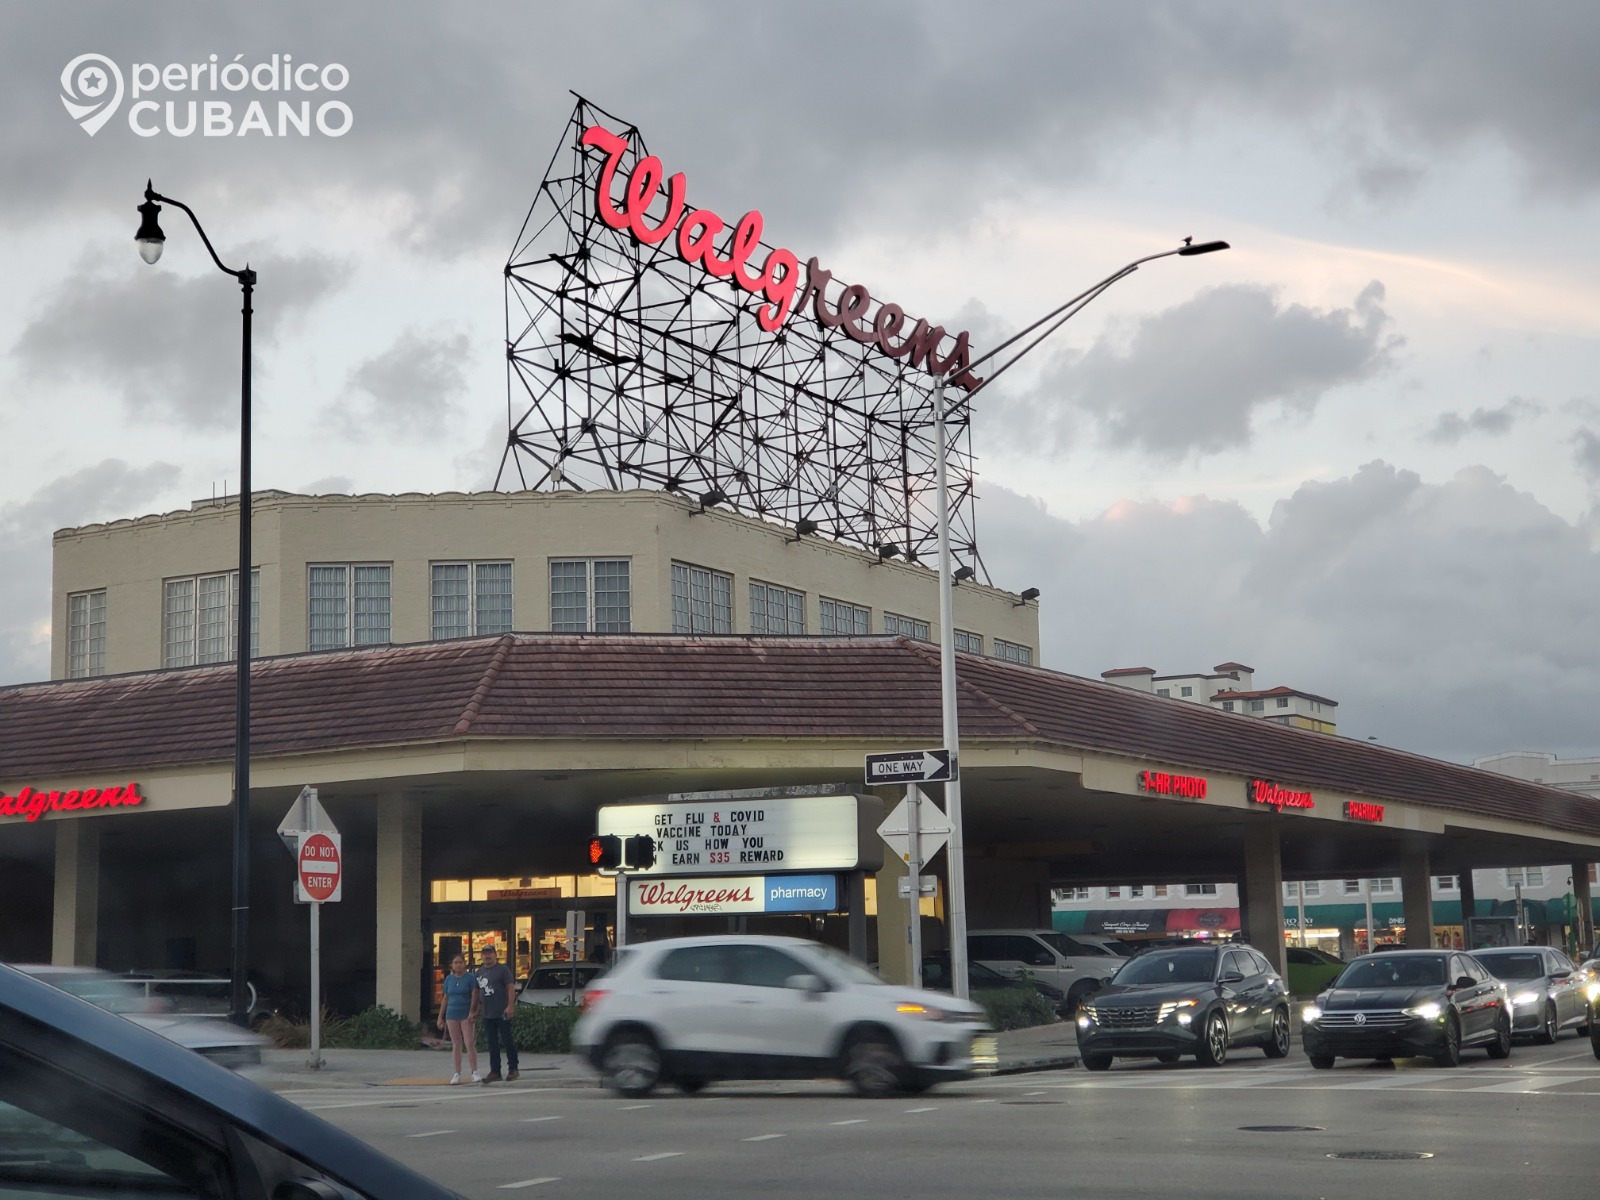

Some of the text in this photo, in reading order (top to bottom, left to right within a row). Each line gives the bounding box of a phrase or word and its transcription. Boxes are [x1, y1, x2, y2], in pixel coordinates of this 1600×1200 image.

[579, 125, 983, 392] Walgreens
[878, 761, 924, 774] ONE WAY
[1144, 770, 1208, 800] 1-HR PHOTO
[0, 782, 143, 822] algreens
[1253, 780, 1315, 813] Walgreens
[654, 810, 765, 826] GET FLU & COVID
[1349, 801, 1385, 822] PHARMACY
[656, 824, 748, 839] VACCINE TODAY
[305, 845, 335, 857] DO NOT
[676, 840, 689, 852] US
[705, 837, 729, 850] HOW
[742, 837, 764, 849] YOU
[672, 853, 700, 865] EARN
[740, 850, 784, 863] REWARD
[308, 876, 332, 888] ENTER
[638, 881, 754, 912] Walgreens
[771, 885, 828, 901] pharmacy
